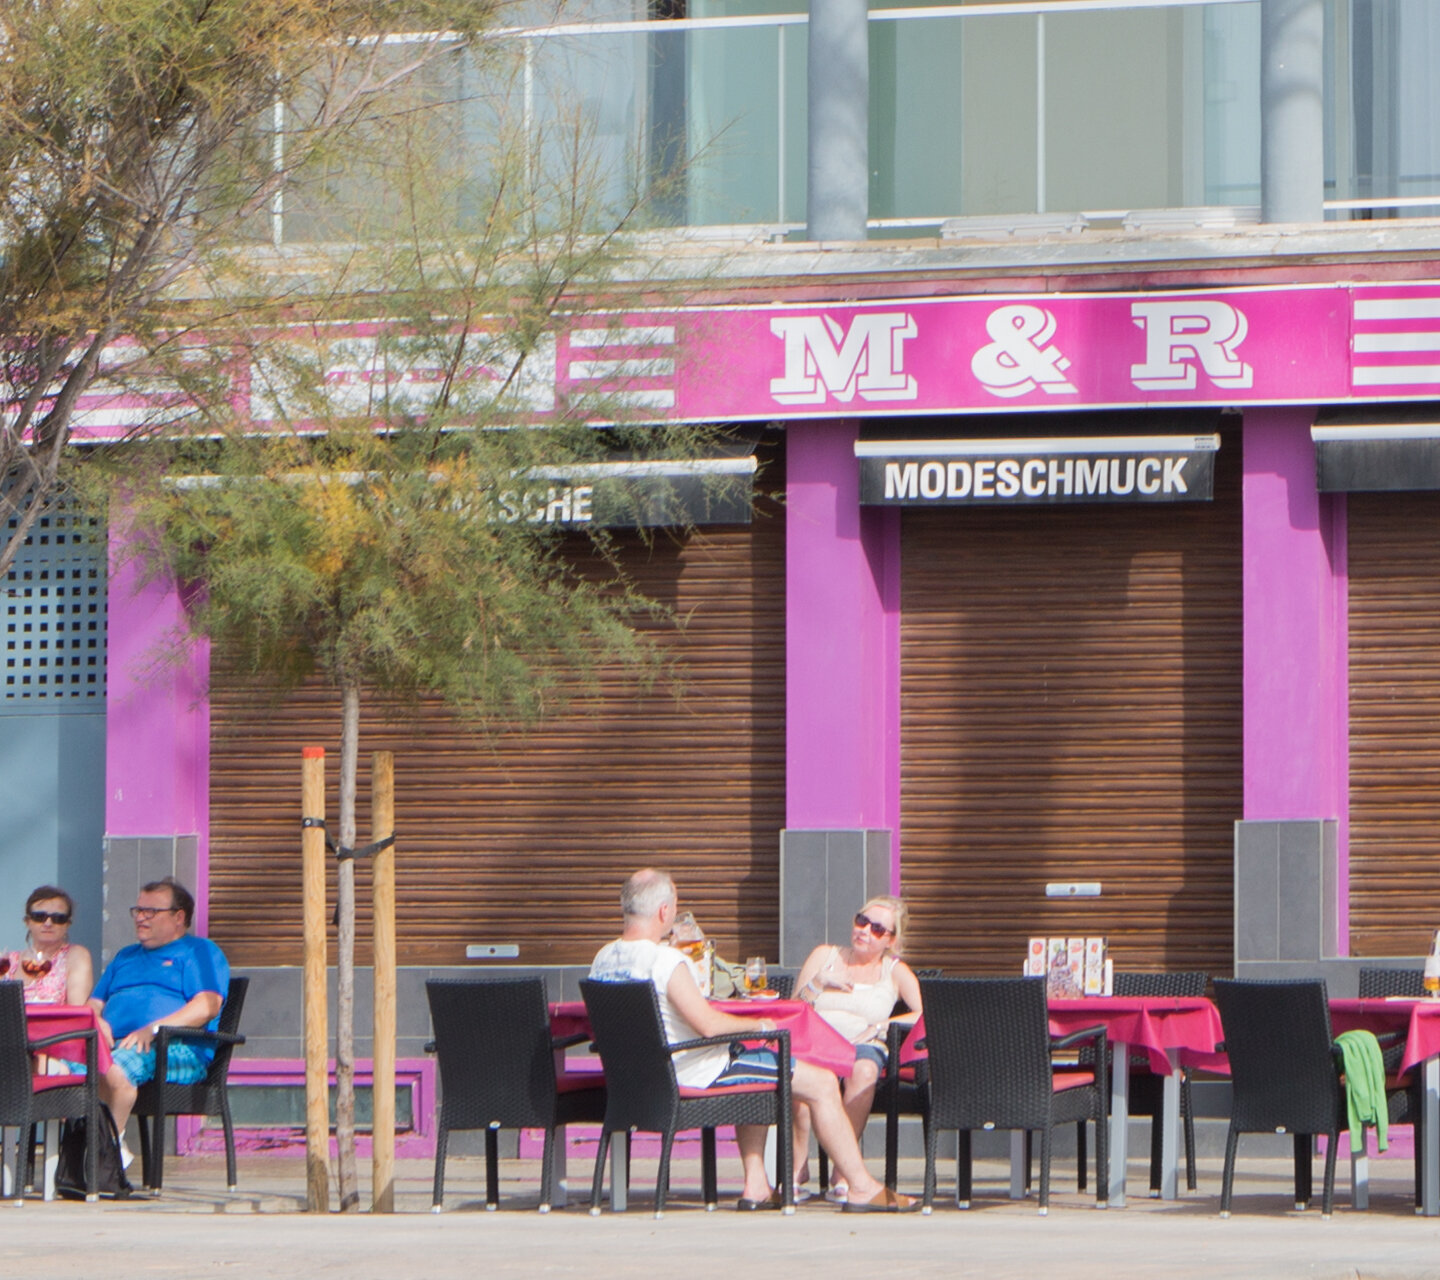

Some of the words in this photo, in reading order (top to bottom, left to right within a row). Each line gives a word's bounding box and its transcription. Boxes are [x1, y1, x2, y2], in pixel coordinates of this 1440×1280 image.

[770, 312, 917, 405] M
[971, 304, 1078, 398] &
[1130, 300, 1254, 391] R
[883, 456, 1189, 500] MODESCHMUCK
